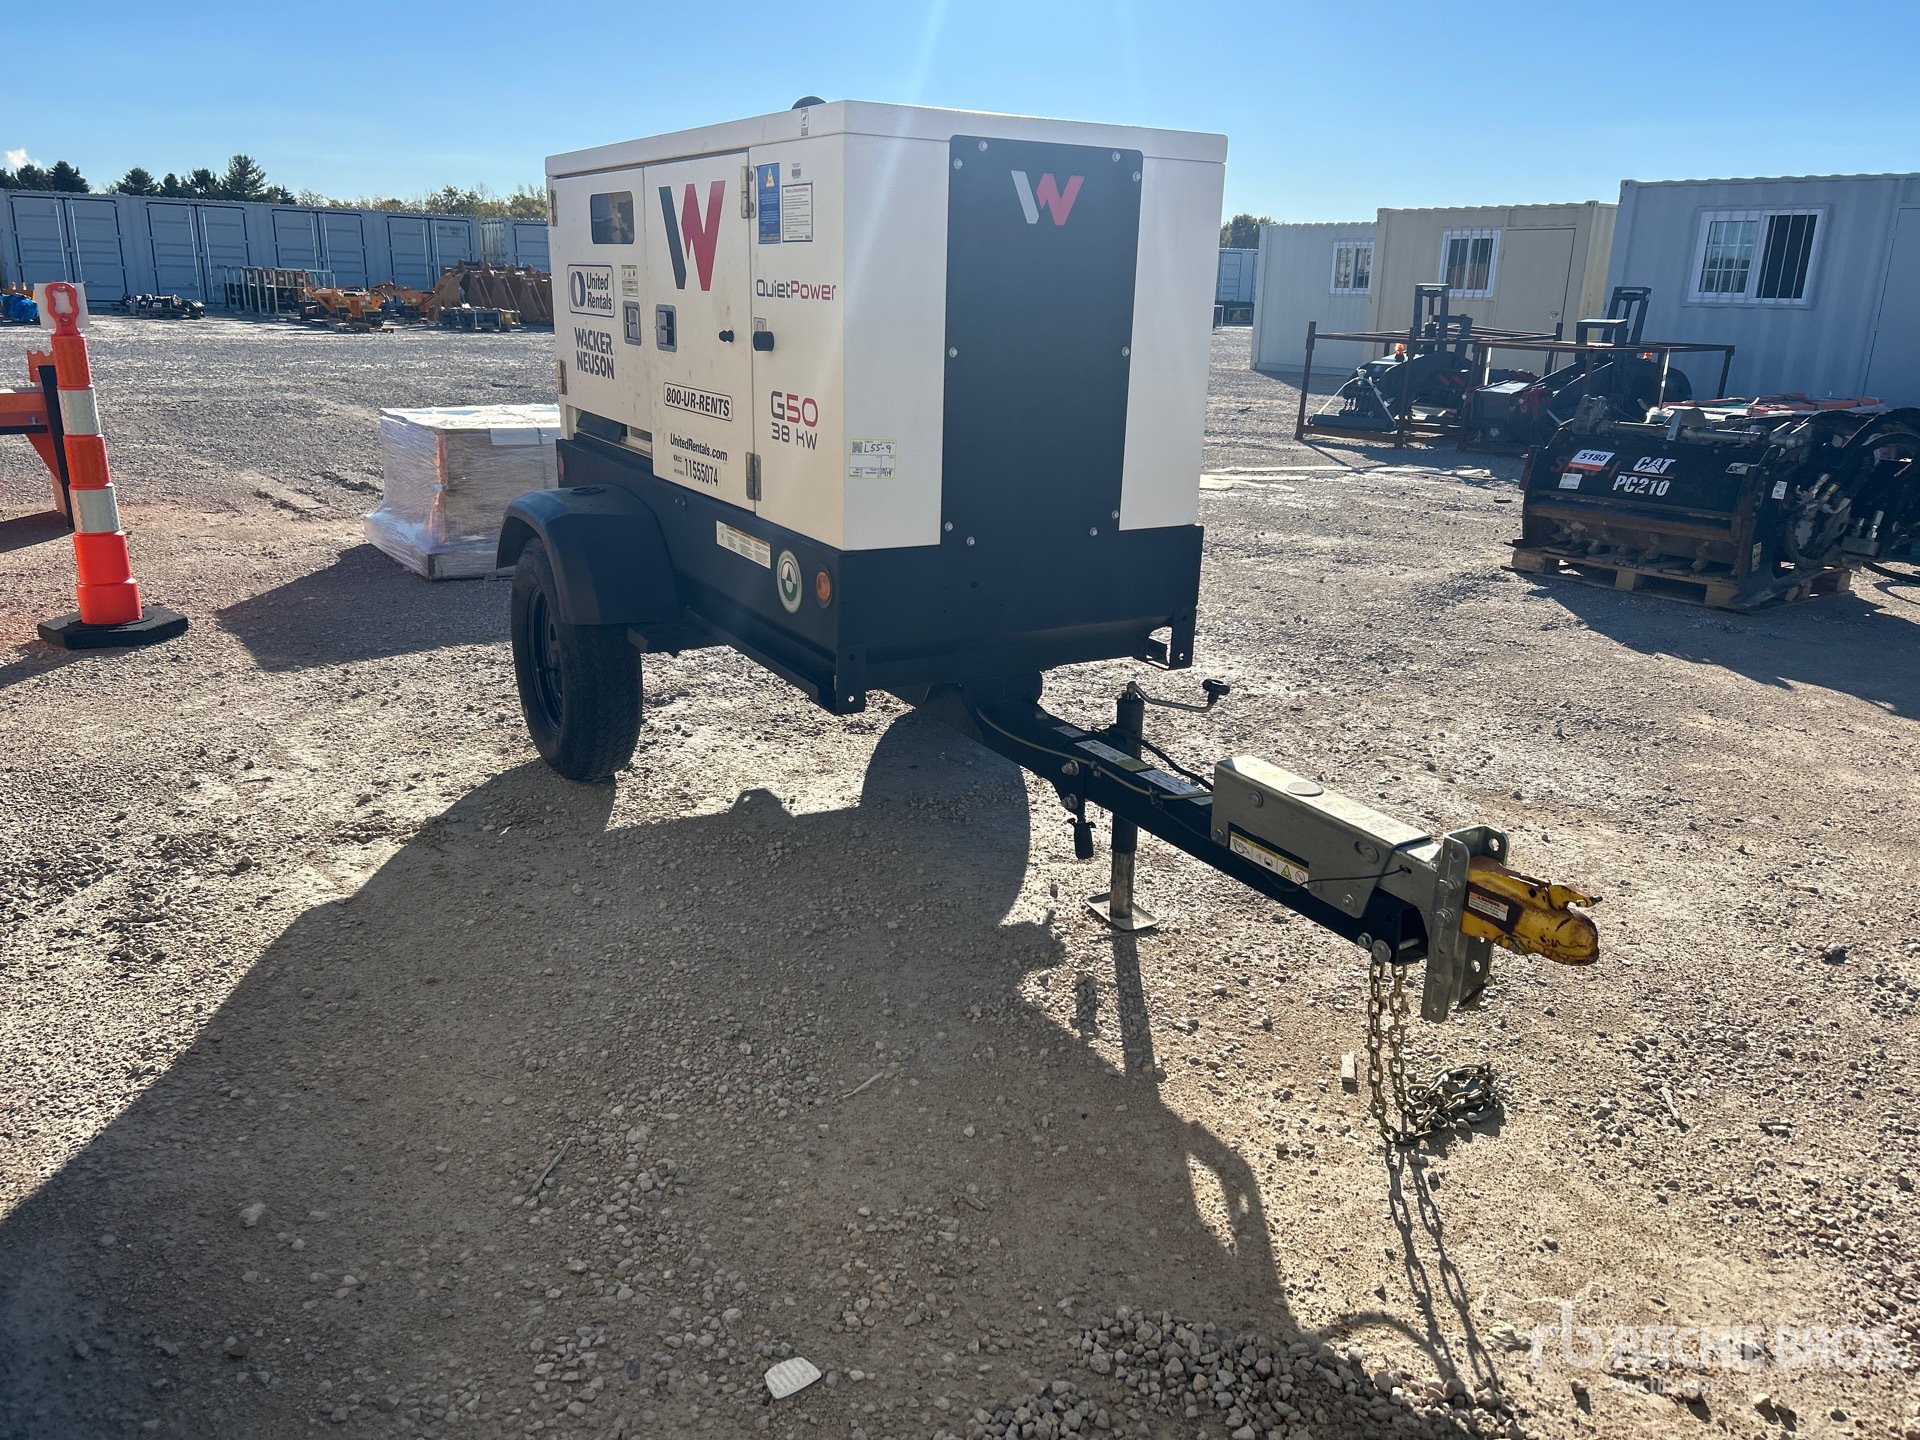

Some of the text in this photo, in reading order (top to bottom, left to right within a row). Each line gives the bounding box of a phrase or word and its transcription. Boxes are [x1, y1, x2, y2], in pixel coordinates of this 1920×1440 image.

[586, 272, 609, 290] United
[756, 279, 837, 300] QuietPower
[587, 291, 612, 311] Rentals
[574, 327, 613, 356] WACKER
[576, 350, 615, 380] NEUSON
[666, 387, 730, 417] 800-UR-RENTS
[771, 390, 818, 427] G50
[771, 422, 790, 443] 38
[670, 432, 728, 462] UnitedRentals.com
[1580, 452, 1608, 462] 5180
[684, 458, 718, 486] 11555074
[1633, 456, 1677, 474] CAT
[1612, 475, 1671, 497] PC210
